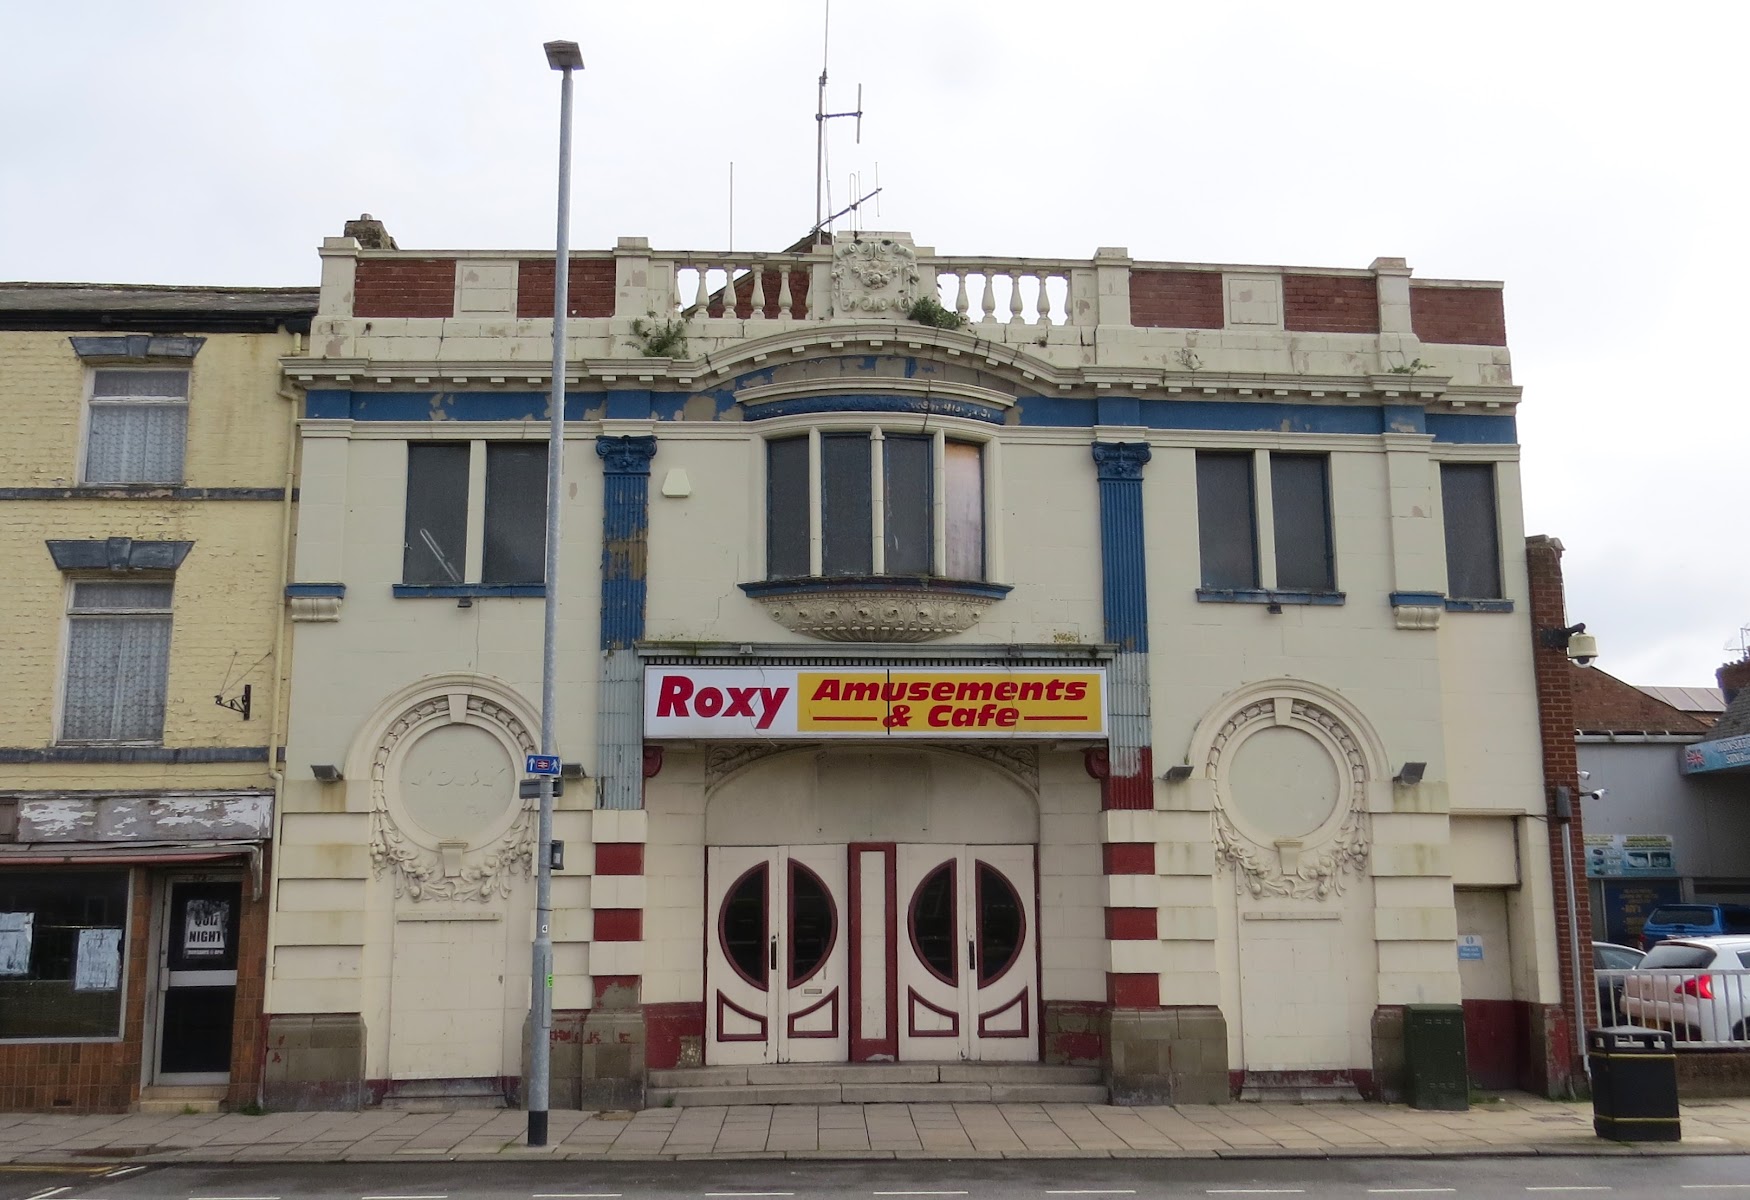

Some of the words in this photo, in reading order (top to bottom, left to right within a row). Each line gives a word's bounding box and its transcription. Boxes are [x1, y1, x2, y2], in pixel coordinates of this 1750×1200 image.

[656, 675, 790, 729] Roxy
[811, 679, 1088, 702] Amusements
[882, 704, 913, 728] &
[927, 703, 1020, 728] Cafe
[189, 931, 221, 942] NIGHT
